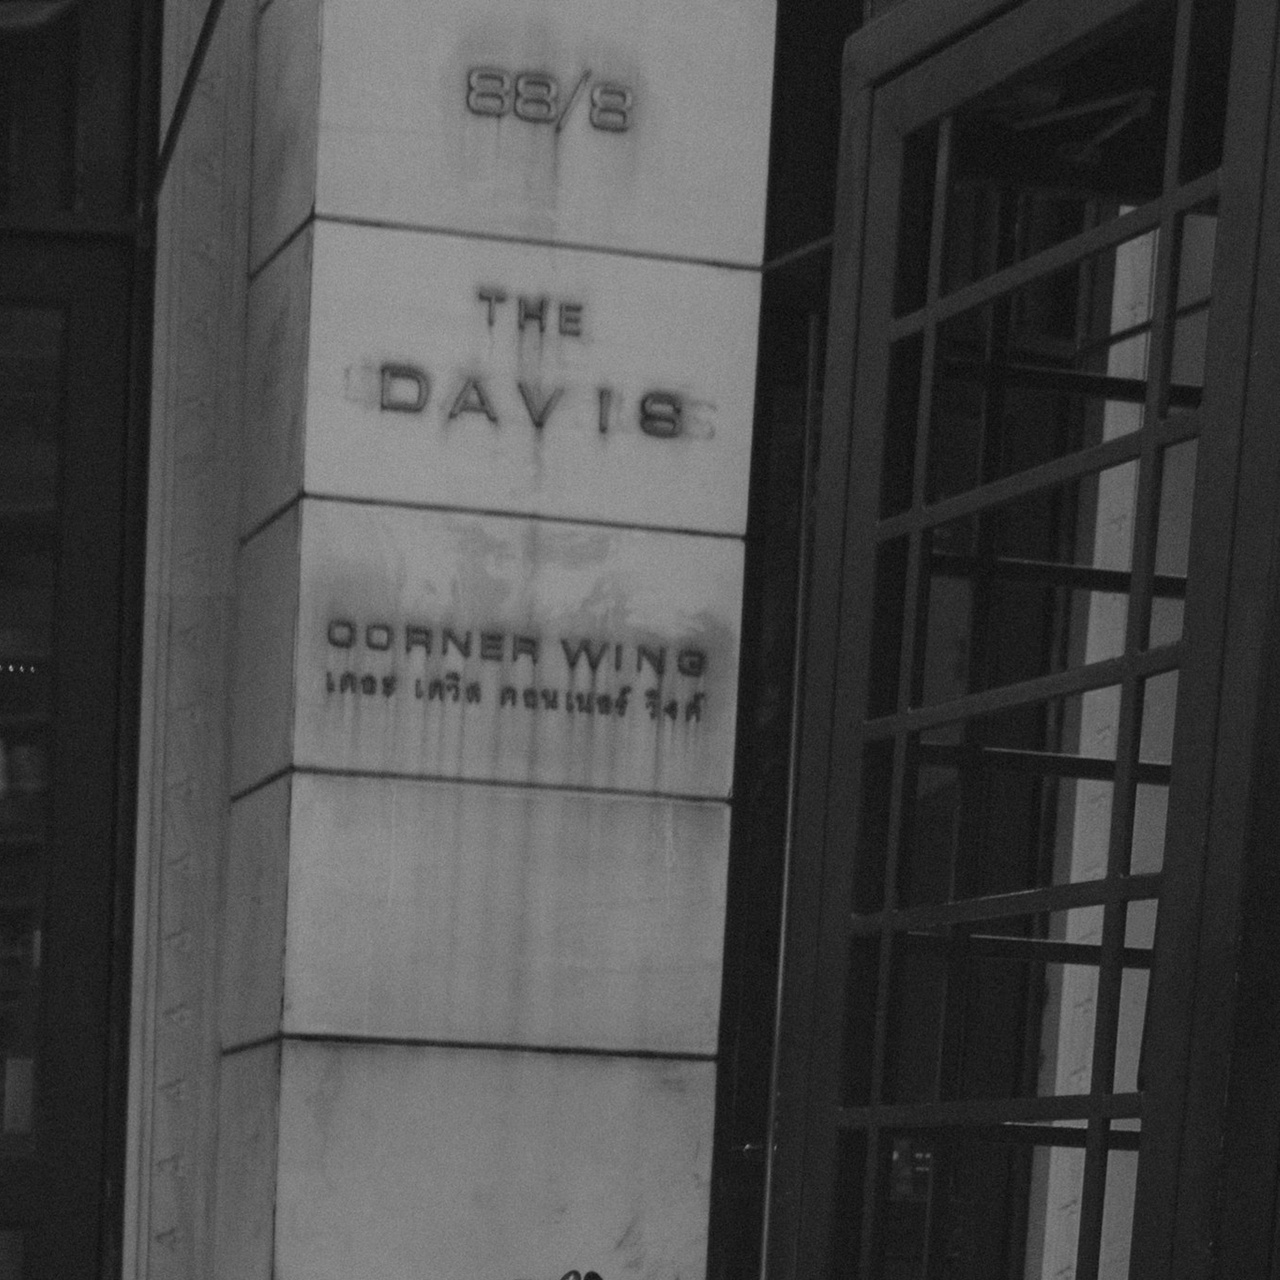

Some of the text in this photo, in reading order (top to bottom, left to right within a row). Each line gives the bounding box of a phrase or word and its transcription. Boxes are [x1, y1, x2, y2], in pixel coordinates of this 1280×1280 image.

[477, 286, 584, 337] THE
[380, 364, 683, 439] DAVIS
[560, 636, 707, 677] WING
